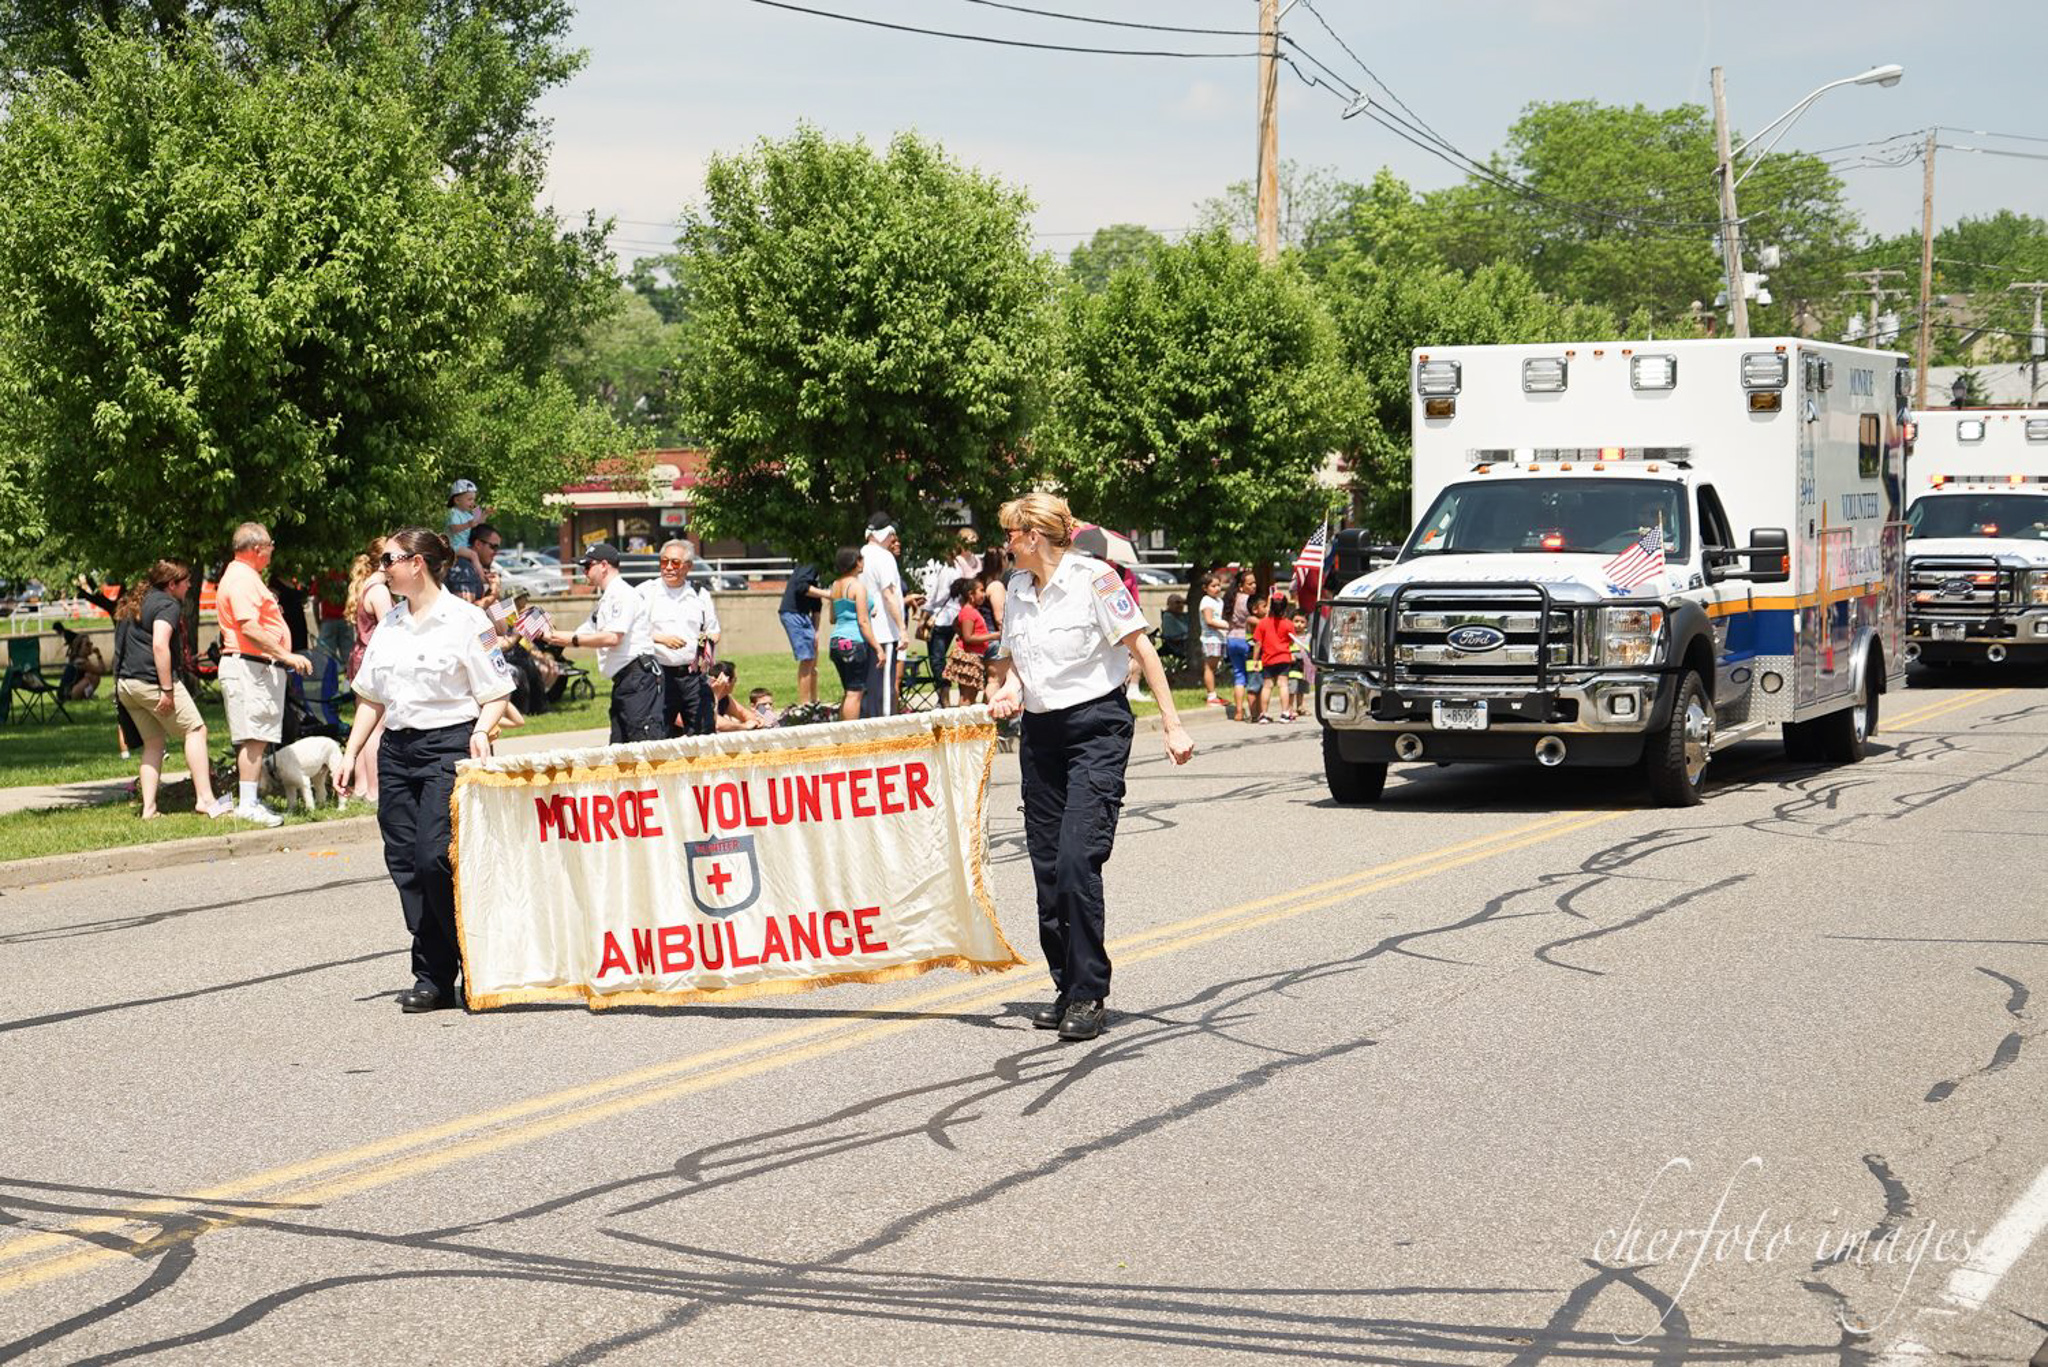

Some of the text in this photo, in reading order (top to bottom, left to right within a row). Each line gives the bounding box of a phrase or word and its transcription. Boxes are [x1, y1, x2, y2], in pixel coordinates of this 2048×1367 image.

[1459, 630, 1491, 645] Ford
[535, 762, 935, 843] MONROE VOLUNTEER
[597, 906, 889, 978] AMBULANCE
